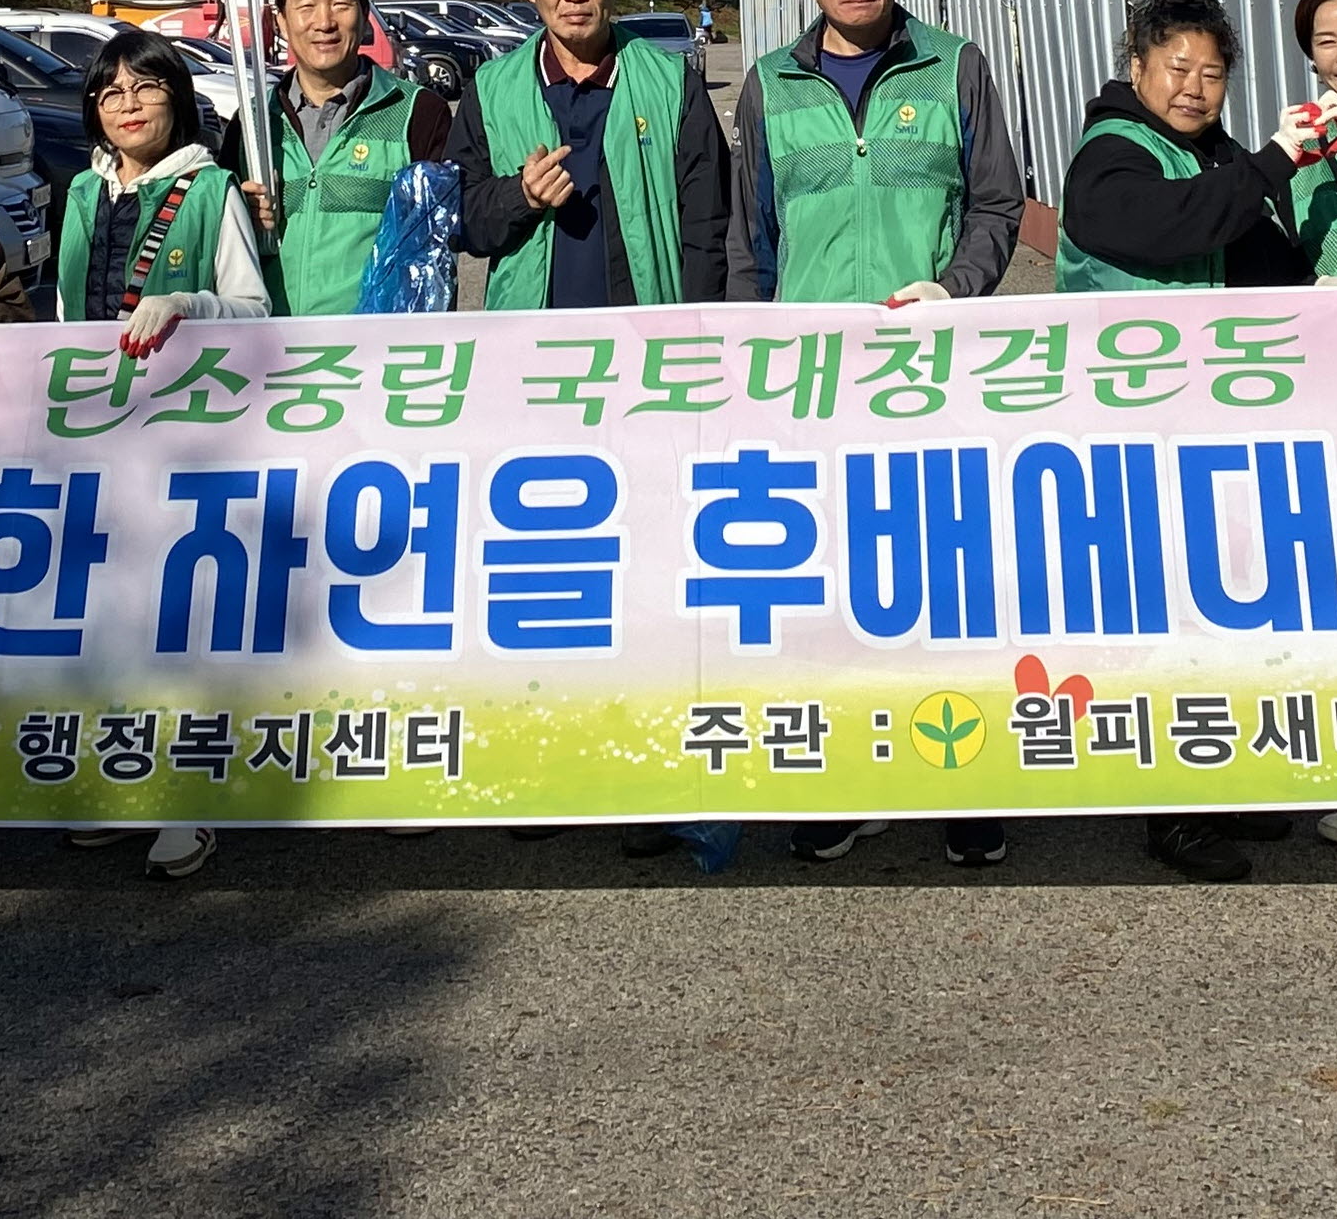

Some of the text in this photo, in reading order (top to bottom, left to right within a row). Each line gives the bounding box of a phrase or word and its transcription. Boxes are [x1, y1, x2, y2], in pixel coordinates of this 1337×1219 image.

[894, 124, 918, 135] SMU
[347, 161, 369, 171] SMU
[41, 312, 1306, 439] 탄소중립 국토대청결운동
[155, 454, 621, 654] 자연을
[18, 710, 462, 780] 행정복지센터
[683, 703, 829, 771] 주관
